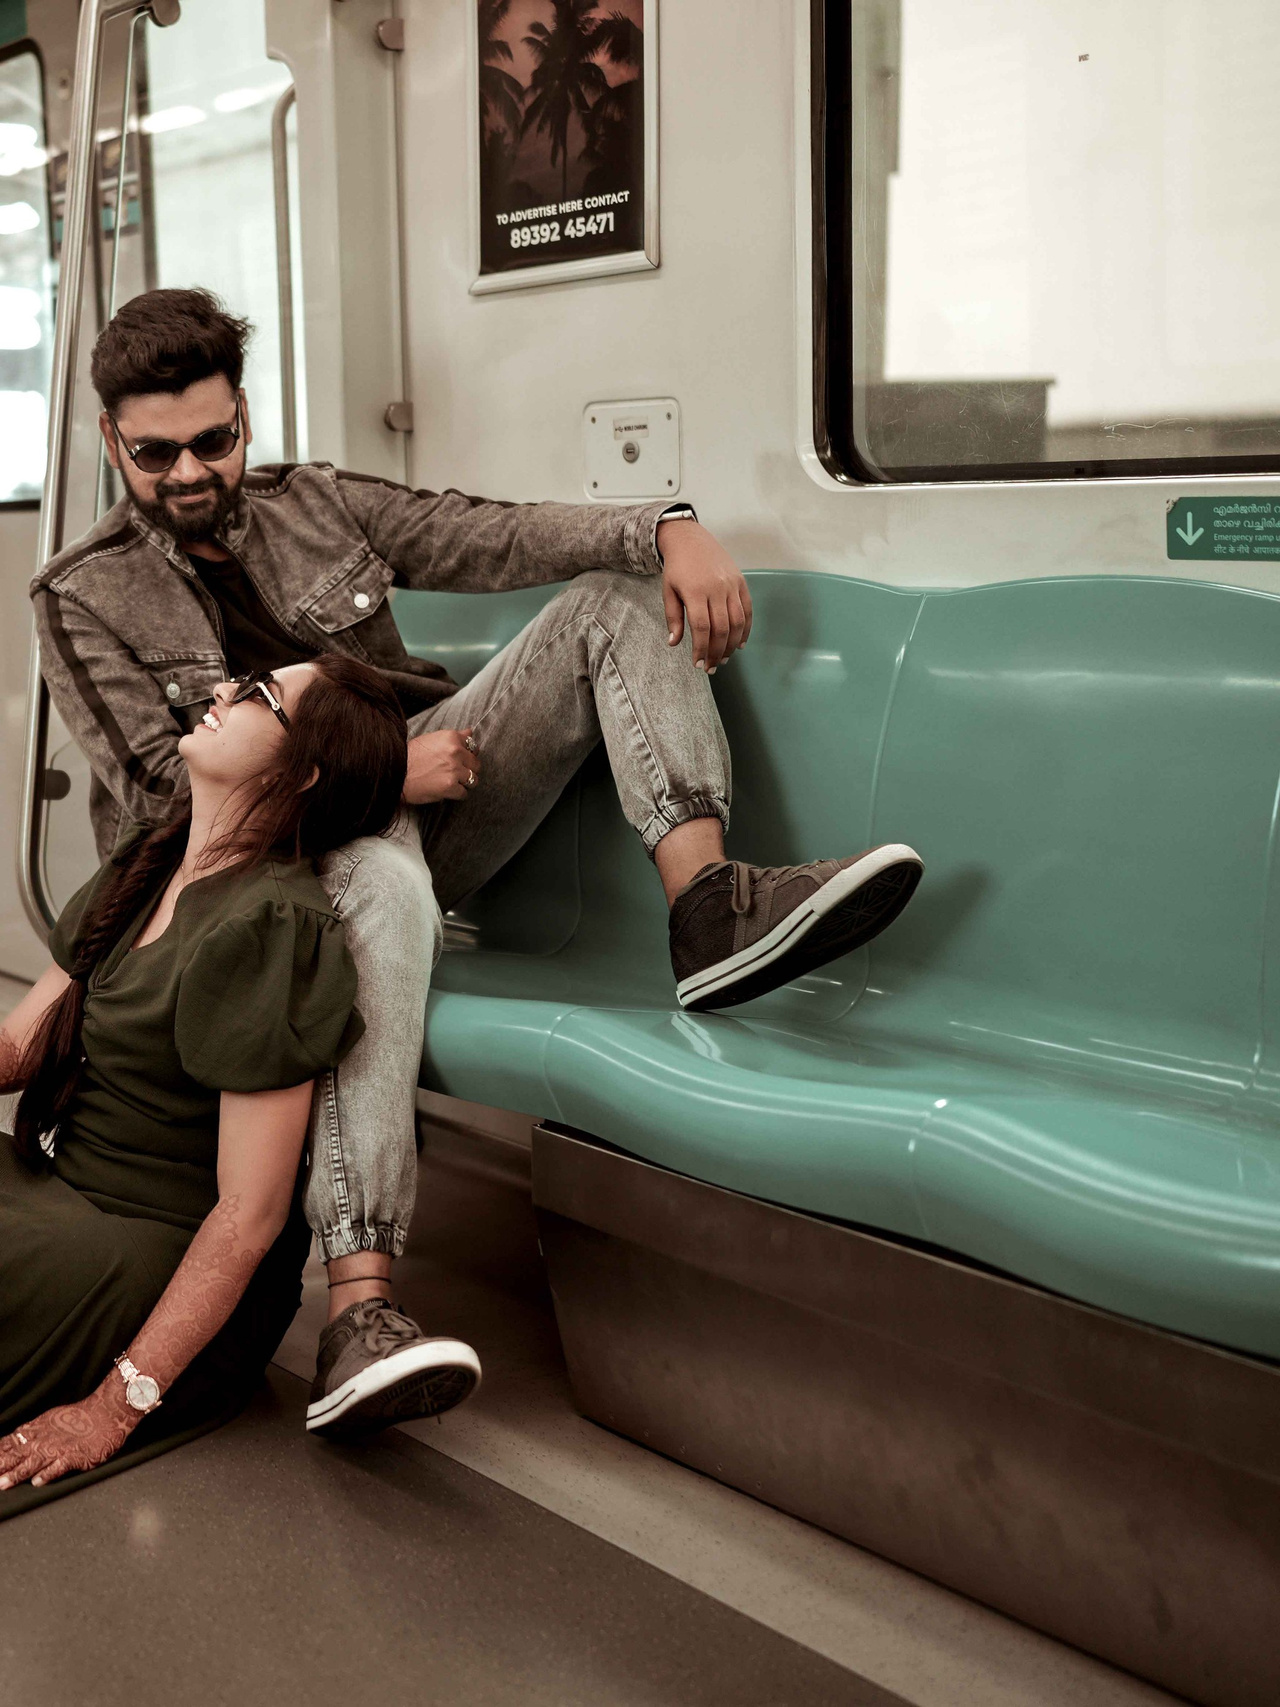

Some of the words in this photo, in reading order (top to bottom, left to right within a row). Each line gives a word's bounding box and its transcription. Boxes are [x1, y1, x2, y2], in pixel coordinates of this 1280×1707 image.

[496, 213, 509, 225] TO
[509, 204, 558, 223] ADVERTISE
[558, 199, 584, 214] HERE
[584, 191, 630, 209] CONTACT
[510, 221, 561, 249] 89392
[564, 211, 615, 239] 45471
[1213, 533, 1253, 542] Emergency
[1255, 534, 1275, 542] ramp
[1214, 544, 1227, 554] सीट
[1228, 544, 1236, 554] के
[1236, 544, 1250, 554] नीचे
